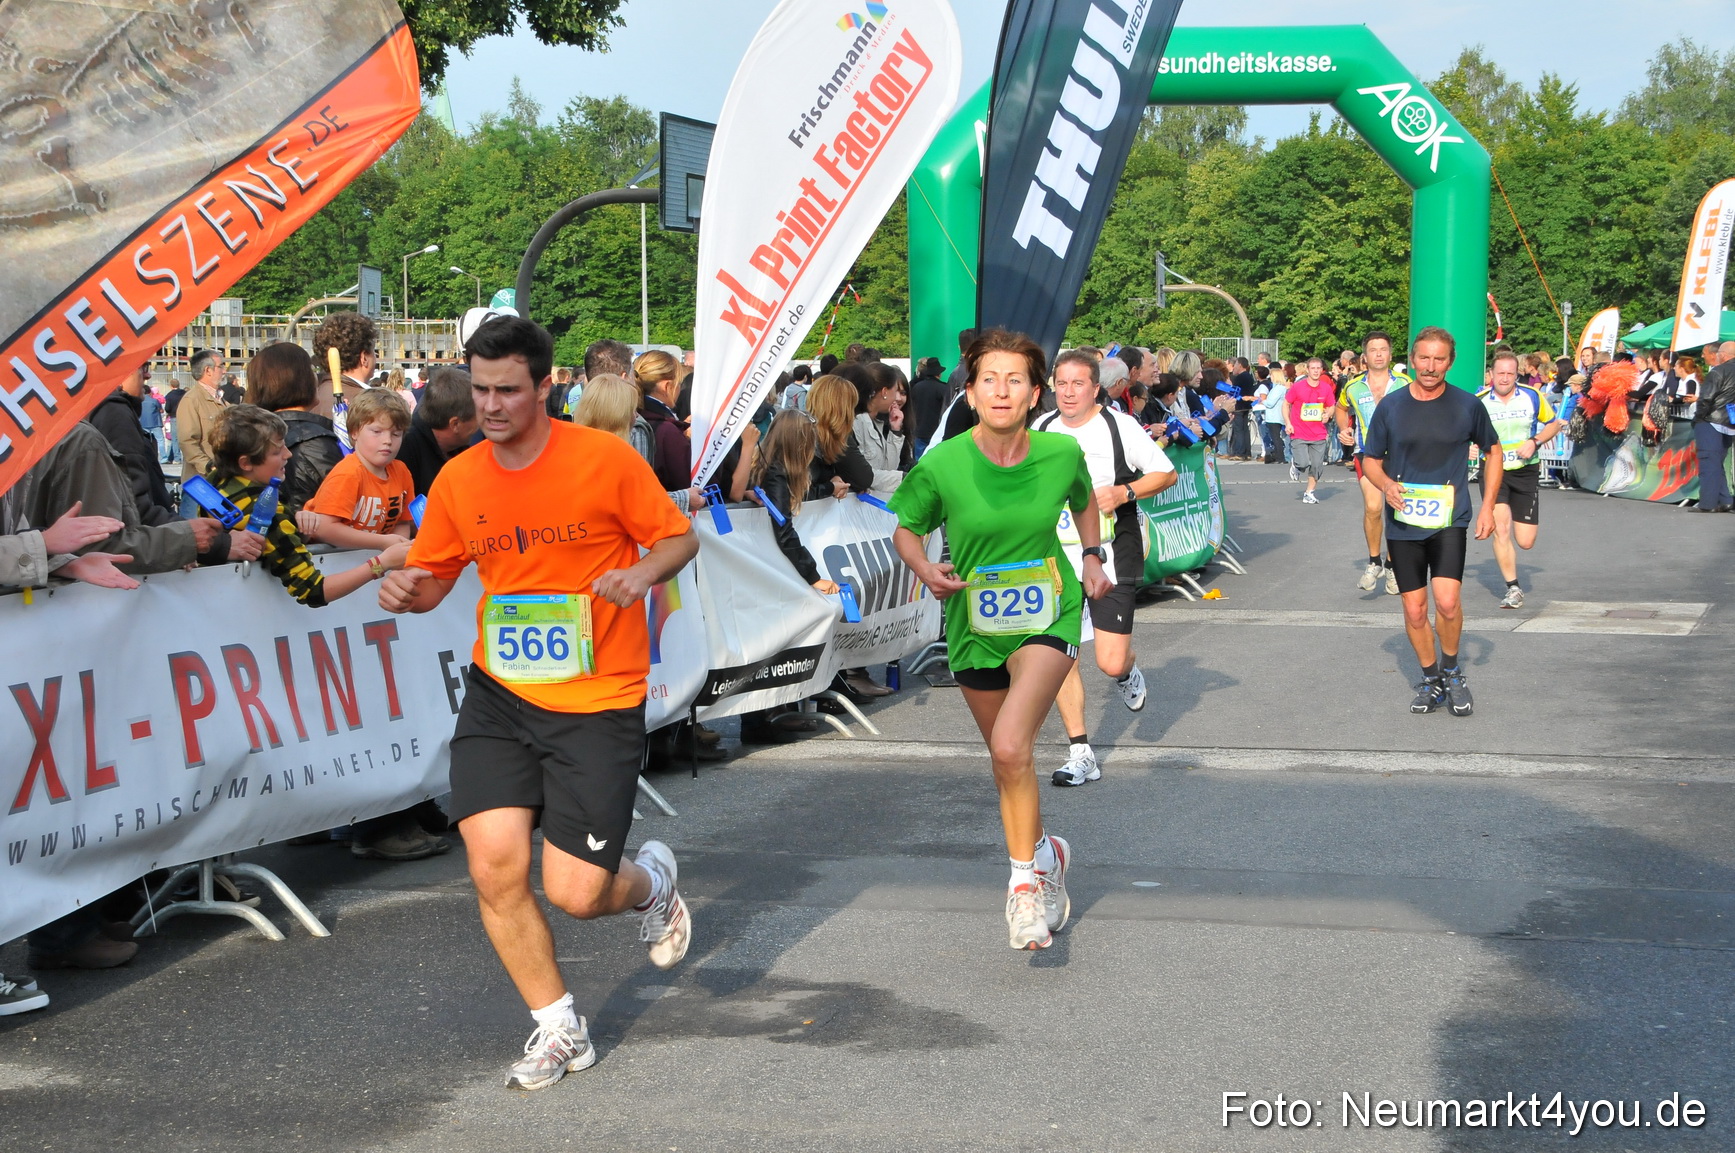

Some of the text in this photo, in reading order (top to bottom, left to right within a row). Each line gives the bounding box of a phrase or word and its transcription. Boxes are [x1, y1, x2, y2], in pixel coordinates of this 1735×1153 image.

[843, 62, 866, 94] Druck
[871, 13, 896, 49] Medien
[788, 21, 877, 149] Frischmann
[1356, 82, 1465, 174] AOK
[749, 176, 839, 292] Print
[812, 27, 934, 191] Factory
[1693, 199, 1723, 295] KLEBL
[1715, 208, 1735, 275] www.klebl.de
[1303, 409, 1318, 417] 340
[1402, 498, 1440, 517] 552
[469, 521, 588, 557] EURO POLES
[978, 585, 1044, 618] 829
[498, 626, 570, 662] 566
[502, 662, 531, 671] Fabian
[770, 658, 815, 677] verbinden
[8, 737, 421, 866] WWW.FRISCHMANN-NET.DE
